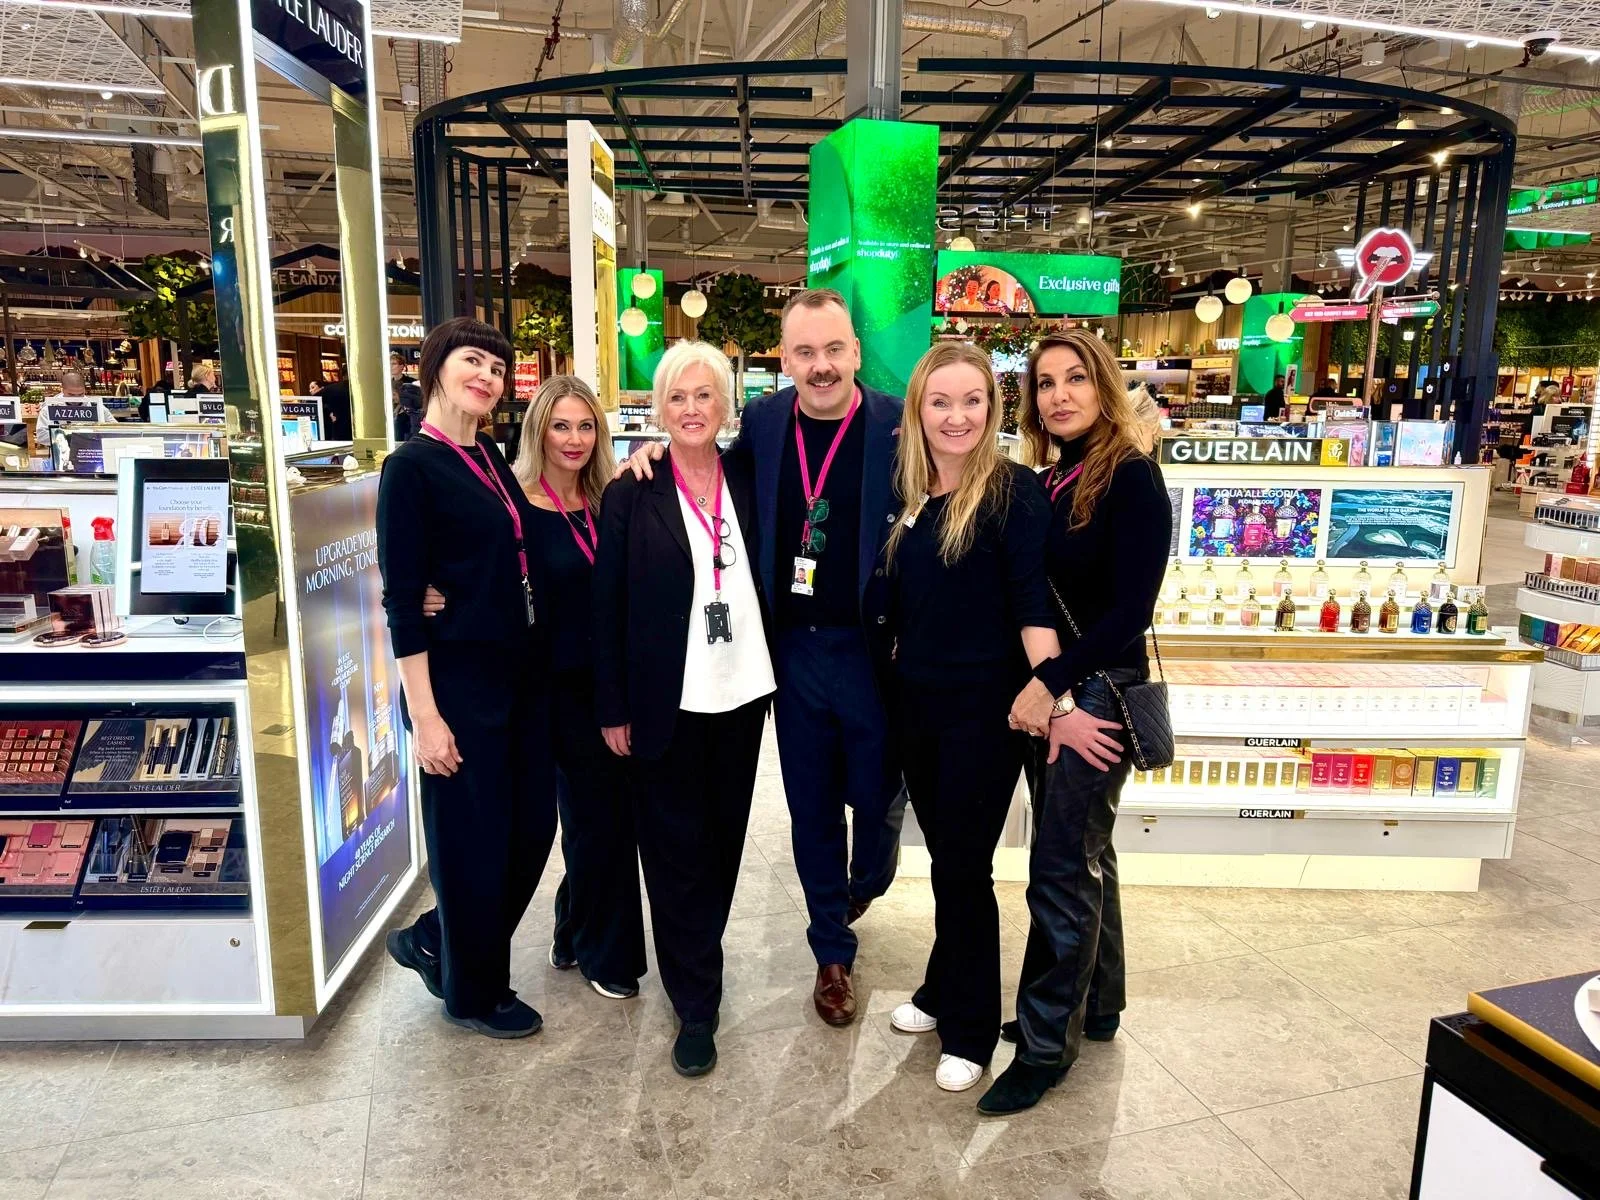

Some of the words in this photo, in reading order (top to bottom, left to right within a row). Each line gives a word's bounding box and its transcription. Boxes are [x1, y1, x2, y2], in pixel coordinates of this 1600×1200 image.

[308, 0, 363, 68] LAUDER
[291, 274, 337, 286] CANDY
[1039, 275, 1101, 291] Exclusive
[1216, 337, 1240, 351] TOYS
[202, 403, 224, 411] BVLG
[280, 406, 315, 414] VLGARI
[54, 409, 93, 419] AZZARO
[1171, 440, 1312, 462] GUERLAIN
[1214, 489, 1244, 498] AQUA
[1245, 489, 1299, 498] ALLEGORIA
[315, 534, 358, 567] UPGRADE
[306, 557, 354, 594] MORNING,
[1247, 738, 1299, 747] GUERLAIN
[1241, 809, 1292, 818] GUERLAIN
[338, 863, 355, 892] NIGHT
[162, 885, 192, 893] LAUDER
